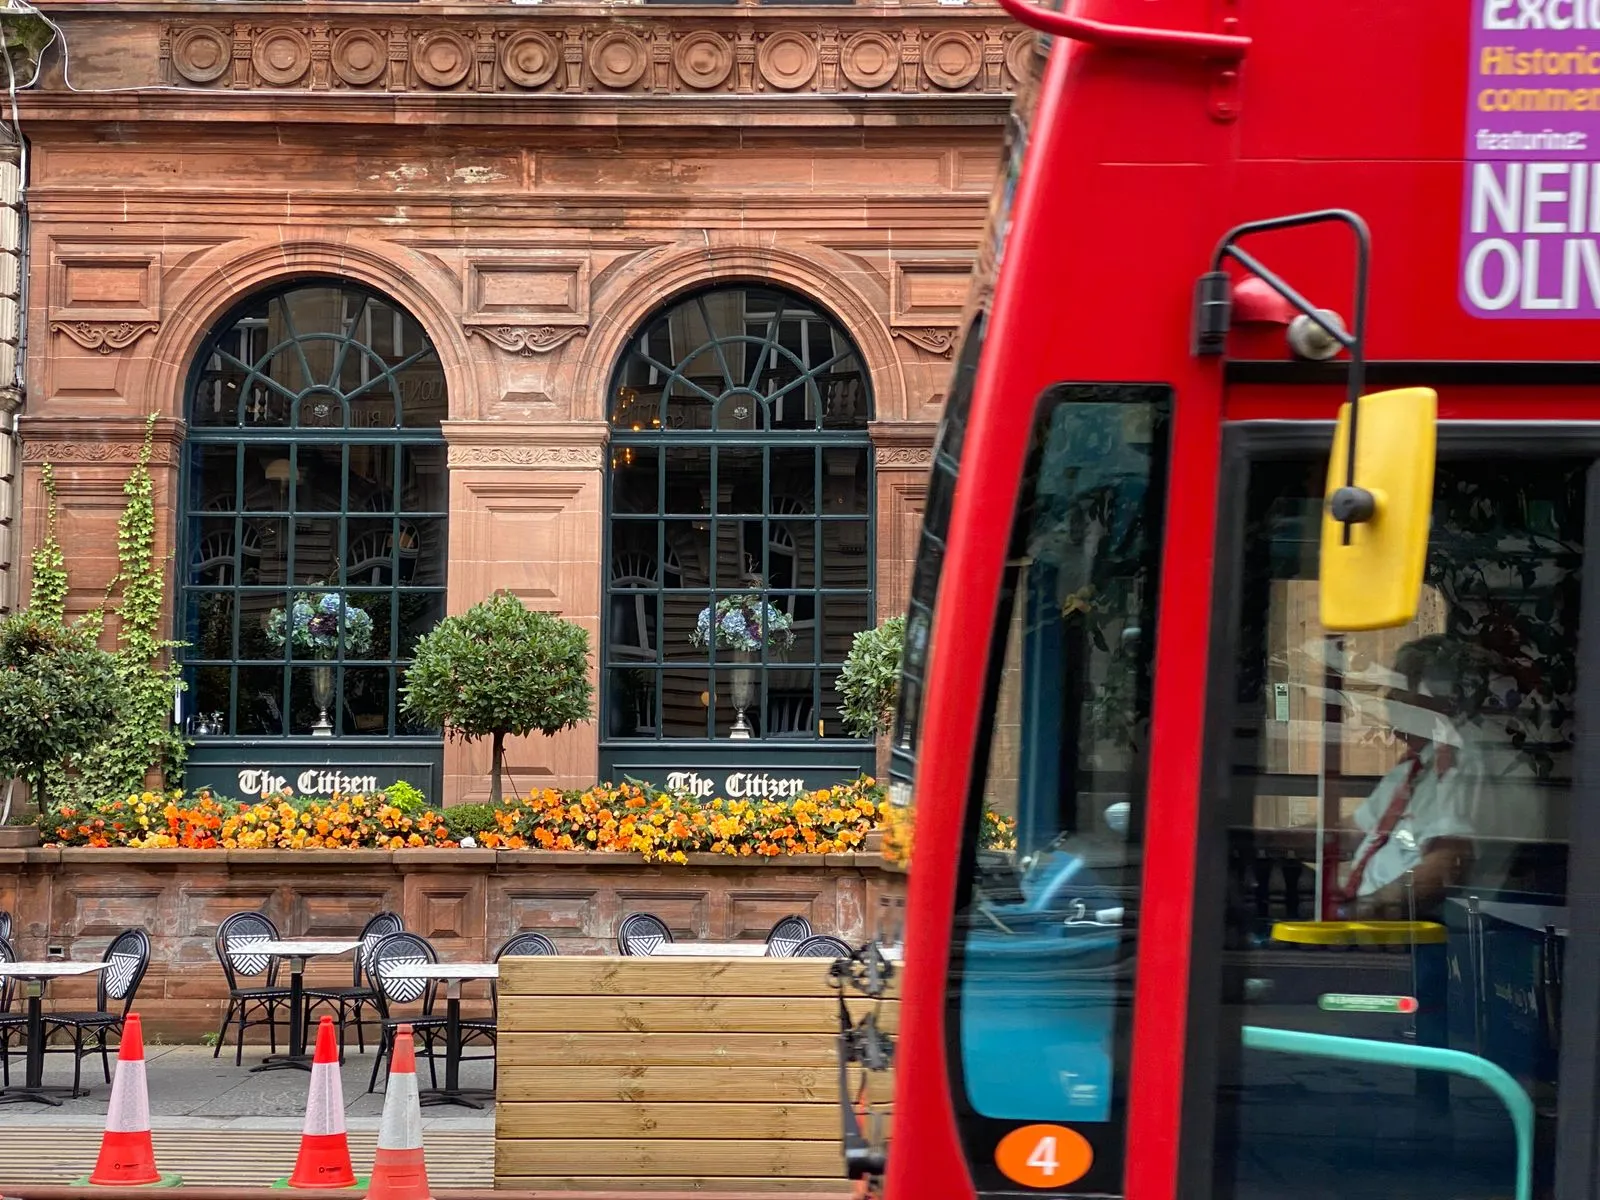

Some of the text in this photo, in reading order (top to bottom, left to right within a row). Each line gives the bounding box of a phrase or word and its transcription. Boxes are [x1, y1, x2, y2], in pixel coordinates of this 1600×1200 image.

[238, 769, 377, 795] The Citizen
[667, 772, 804, 800] The Citizen
[1026, 1136, 1060, 1176] 4
